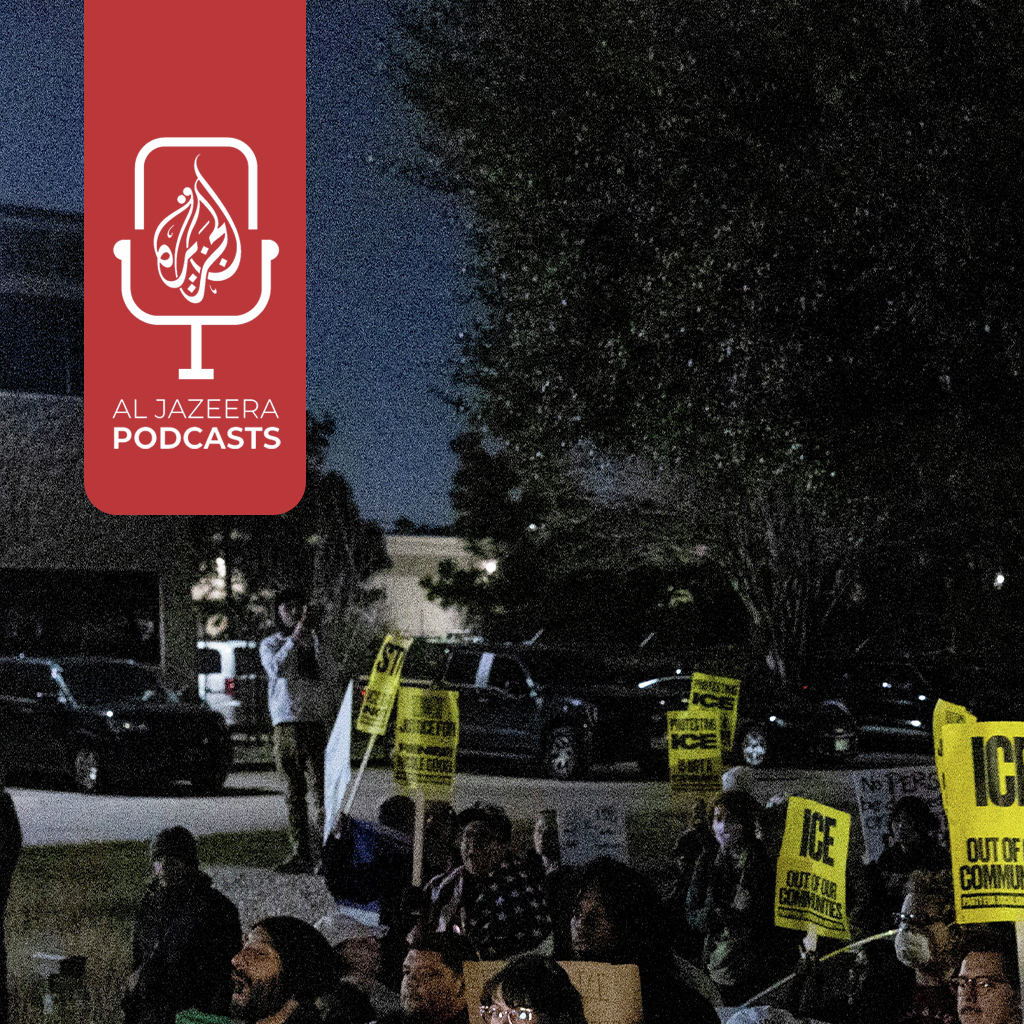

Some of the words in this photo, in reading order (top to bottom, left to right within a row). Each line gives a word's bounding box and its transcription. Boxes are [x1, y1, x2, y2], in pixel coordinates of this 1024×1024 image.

[671, 733, 718, 750] ICE
[799, 808, 837, 867] ICE
[967, 837, 999, 863] OUT
[1002, 837, 1020, 863] OF
